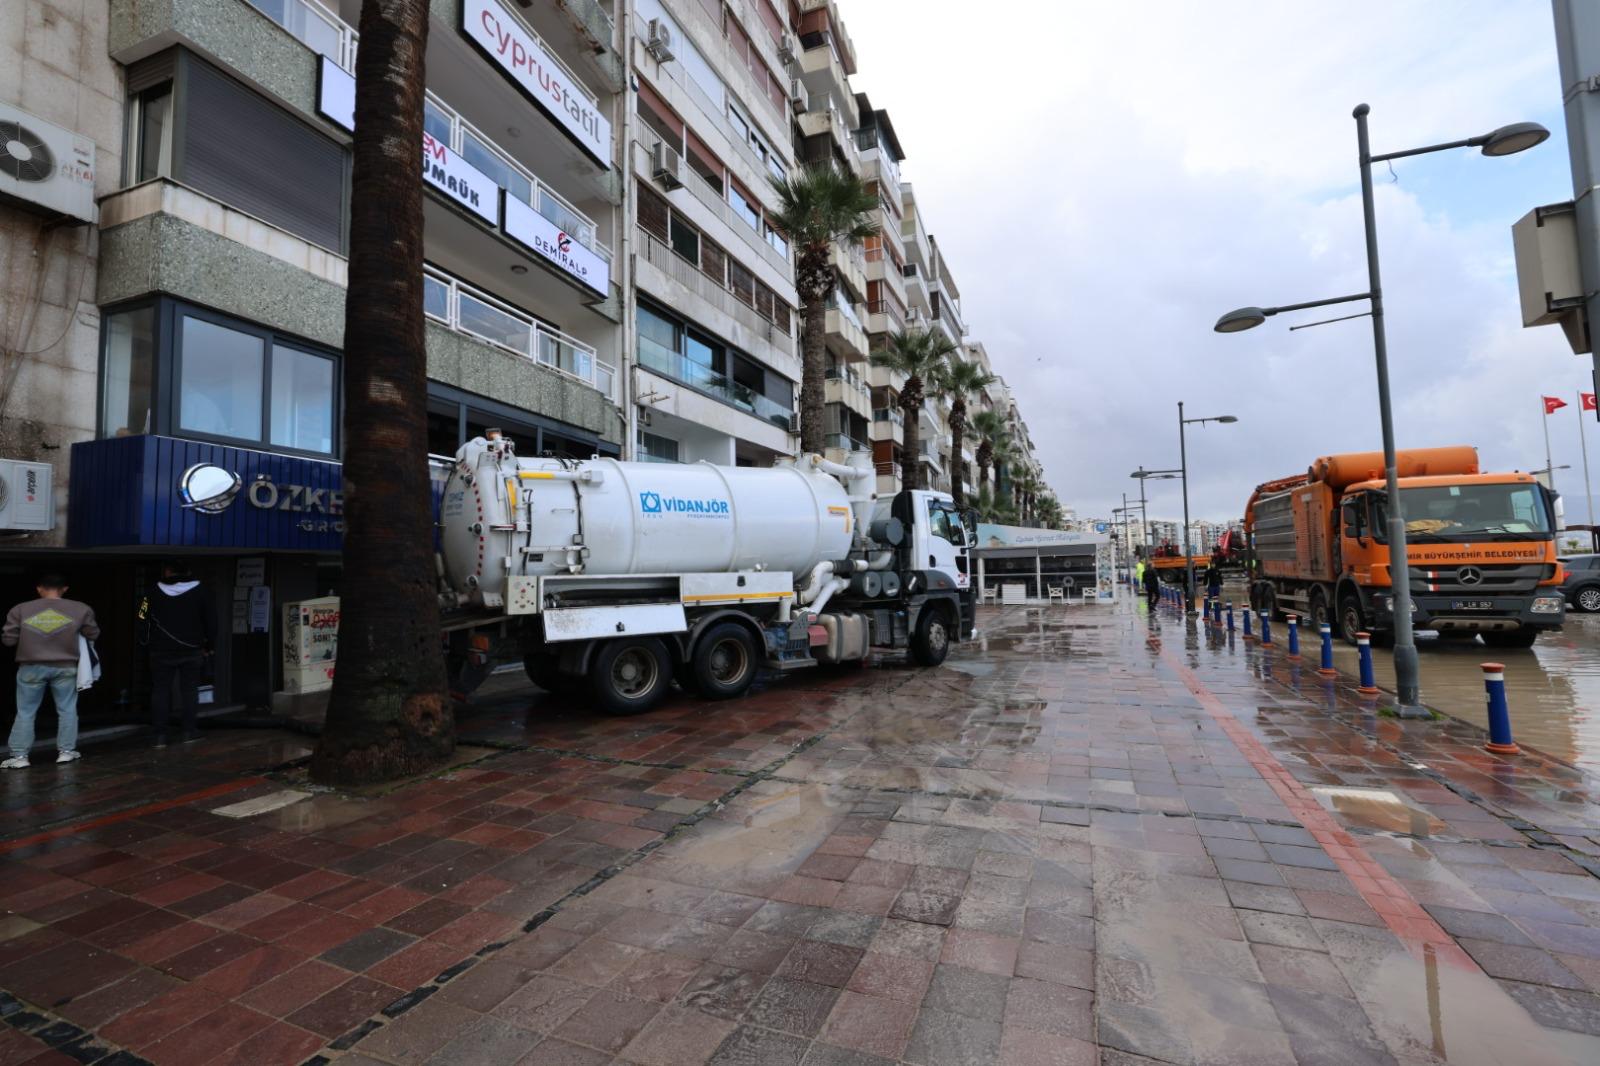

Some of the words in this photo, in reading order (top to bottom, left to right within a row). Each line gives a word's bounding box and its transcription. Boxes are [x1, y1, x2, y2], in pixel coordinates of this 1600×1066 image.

[481, 10, 601, 144] cyprustatil
[423, 153, 480, 208] ÜMRÜK
[249, 473, 344, 515] ÖZKE
[663, 496, 729, 513] VİDANJÖR
[1424, 551, 1482, 561] BÜYÜKŞEHİR
